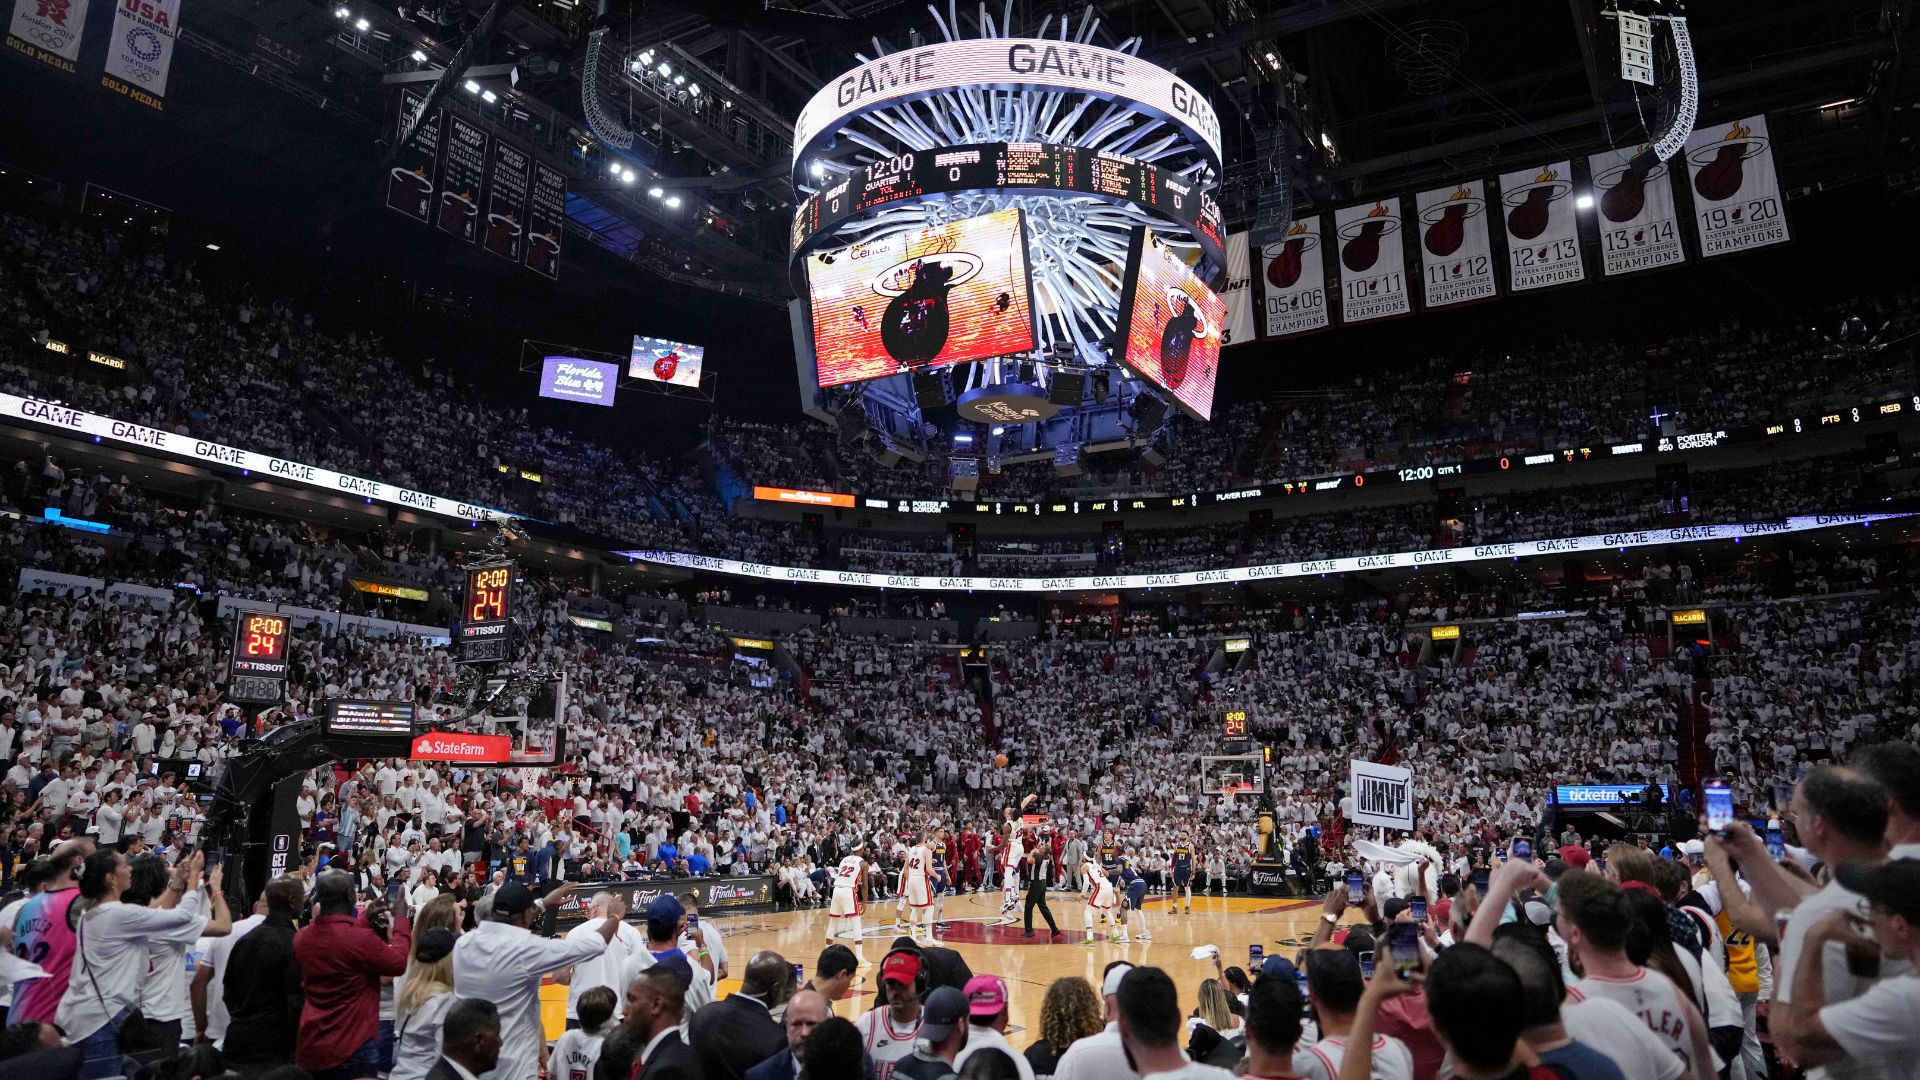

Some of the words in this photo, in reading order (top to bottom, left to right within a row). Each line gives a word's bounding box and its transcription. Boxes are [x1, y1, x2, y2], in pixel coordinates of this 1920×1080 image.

[118, 6, 136, 22] MEN'S
[136, 16, 174, 38] BASKETBALL
[125, 0, 169, 28] USA
[6, 36, 34, 55] GOLD
[37, 52, 76, 74] MEDAL
[1008, 44, 1126, 89] GAME
[837, 50, 935, 108] GAME
[101, 77, 128, 95] GOLD
[130, 88, 164, 111] MEDAL
[455, 122, 482, 141] MIAMI
[459, 133, 484, 148] HEAT
[499, 146, 524, 162] MIAMI
[503, 156, 526, 170] HEAT
[865, 153, 914, 181] 12:00
[538, 166, 562, 183] MIAMI
[949, 168, 961, 182] 0
[542, 176, 564, 190] HEAT
[865, 175, 900, 191] QUARTER
[831, 199, 839, 213] 0
[1702, 209, 1728, 232] 19
[1748, 198, 1778, 222] 20
[1605, 230, 1630, 251] 13
[1650, 222, 1674, 243] 14
[1706, 228, 1783, 252] CHAMPIONS
[1512, 248, 1534, 268] 12
[1553, 239, 1576, 260] 13
[1608, 250, 1680, 272] CHAMPIONS
[1428, 264, 1448, 284] 11
[1467, 256, 1488, 276] 12
[1514, 268, 1580, 288] CHAMPIONS
[1347, 280, 1367, 300] 10
[1382, 274, 1402, 294] 11
[1430, 284, 1492, 304] CHAMPIONS
[1268, 296, 1288, 314] 05
[1302, 289, 1323, 309] 06
[1346, 301, 1406, 319] CHAMPIONS
[1270, 316, 1326, 333] CHAMPIONS
[557, 364, 603, 380] Florida
[555, 375, 582, 388] Blue
[21, 400, 84, 428] GAME
[112, 422, 166, 447] GAME
[1658, 444, 1674, 452] #50
[1678, 438, 1718, 451] GORDON
[1766, 425, 1784, 435] MIN
[1821, 414, 1840, 424] PTS
[1880, 403, 1901, 414] REB
[1677, 432, 1712, 444] PORTER
[1714, 431, 1728, 440] JR.
[195, 441, 246, 465] GAME
[269, 459, 315, 482] GAME
[1500, 457, 1509, 470] 0
[1398, 466, 1434, 482] 12:00
[1438, 466, 1454, 476] QTR
[1456, 464, 1462, 474] 1
[338, 475, 380, 496] GAME
[1316, 478, 1342, 490] HEAT
[1354, 474, 1364, 488] 0
[399, 490, 437, 510] GAME
[1092, 502, 1106, 510] AST
[1172, 498, 1184, 506] BLK
[1216, 492, 1240, 502] PLAYER
[1241, 490, 1261, 499] STATS
[457, 504, 492, 520] GAME
[1670, 526, 1716, 540] GAME
[1744, 518, 1791, 534] GAME
[1536, 538, 1578, 552] GAME
[1604, 532, 1649, 546] GAME
[1414, 550, 1453, 563] GAME
[1474, 544, 1516, 558] GAME
[1300, 560, 1337, 573] GAME
[1358, 554, 1396, 568] GAME
[741, 563, 772, 576] GAME
[787, 568, 820, 580] GAME
[1196, 570, 1230, 582] GAME
[1248, 565, 1284, 578] GAME
[477, 569, 508, 588] 12:00
[839, 573, 872, 584] GAME
[888, 576, 920, 587] GAME
[940, 578, 973, 588] GAME
[990, 578, 1023, 589] GAME
[1042, 578, 1076, 589] GAME
[1092, 576, 1127, 587] GAME
[1146, 574, 1180, 586] GAME
[474, 590, 502, 621] 24
[1674, 612, 1706, 622] BACARDÍ
[250, 618, 282, 636] 12:00
[475, 625, 506, 636] TISSOT
[248, 634, 275, 654] 24
[250, 662, 285, 672] TISSOT
[1226, 712, 1245, 721] 12:00
[1226, 721, 1244, 734] 24
[272, 853, 288, 868] GET
[909, 858, 920, 870] 42
[839, 865, 855, 878] 22
[1258, 871, 1284, 886] Finals
[714, 884, 736, 904] Finals
[20, 918, 52, 937] BUTLER
[566, 1051, 592, 1068] LOWRY
